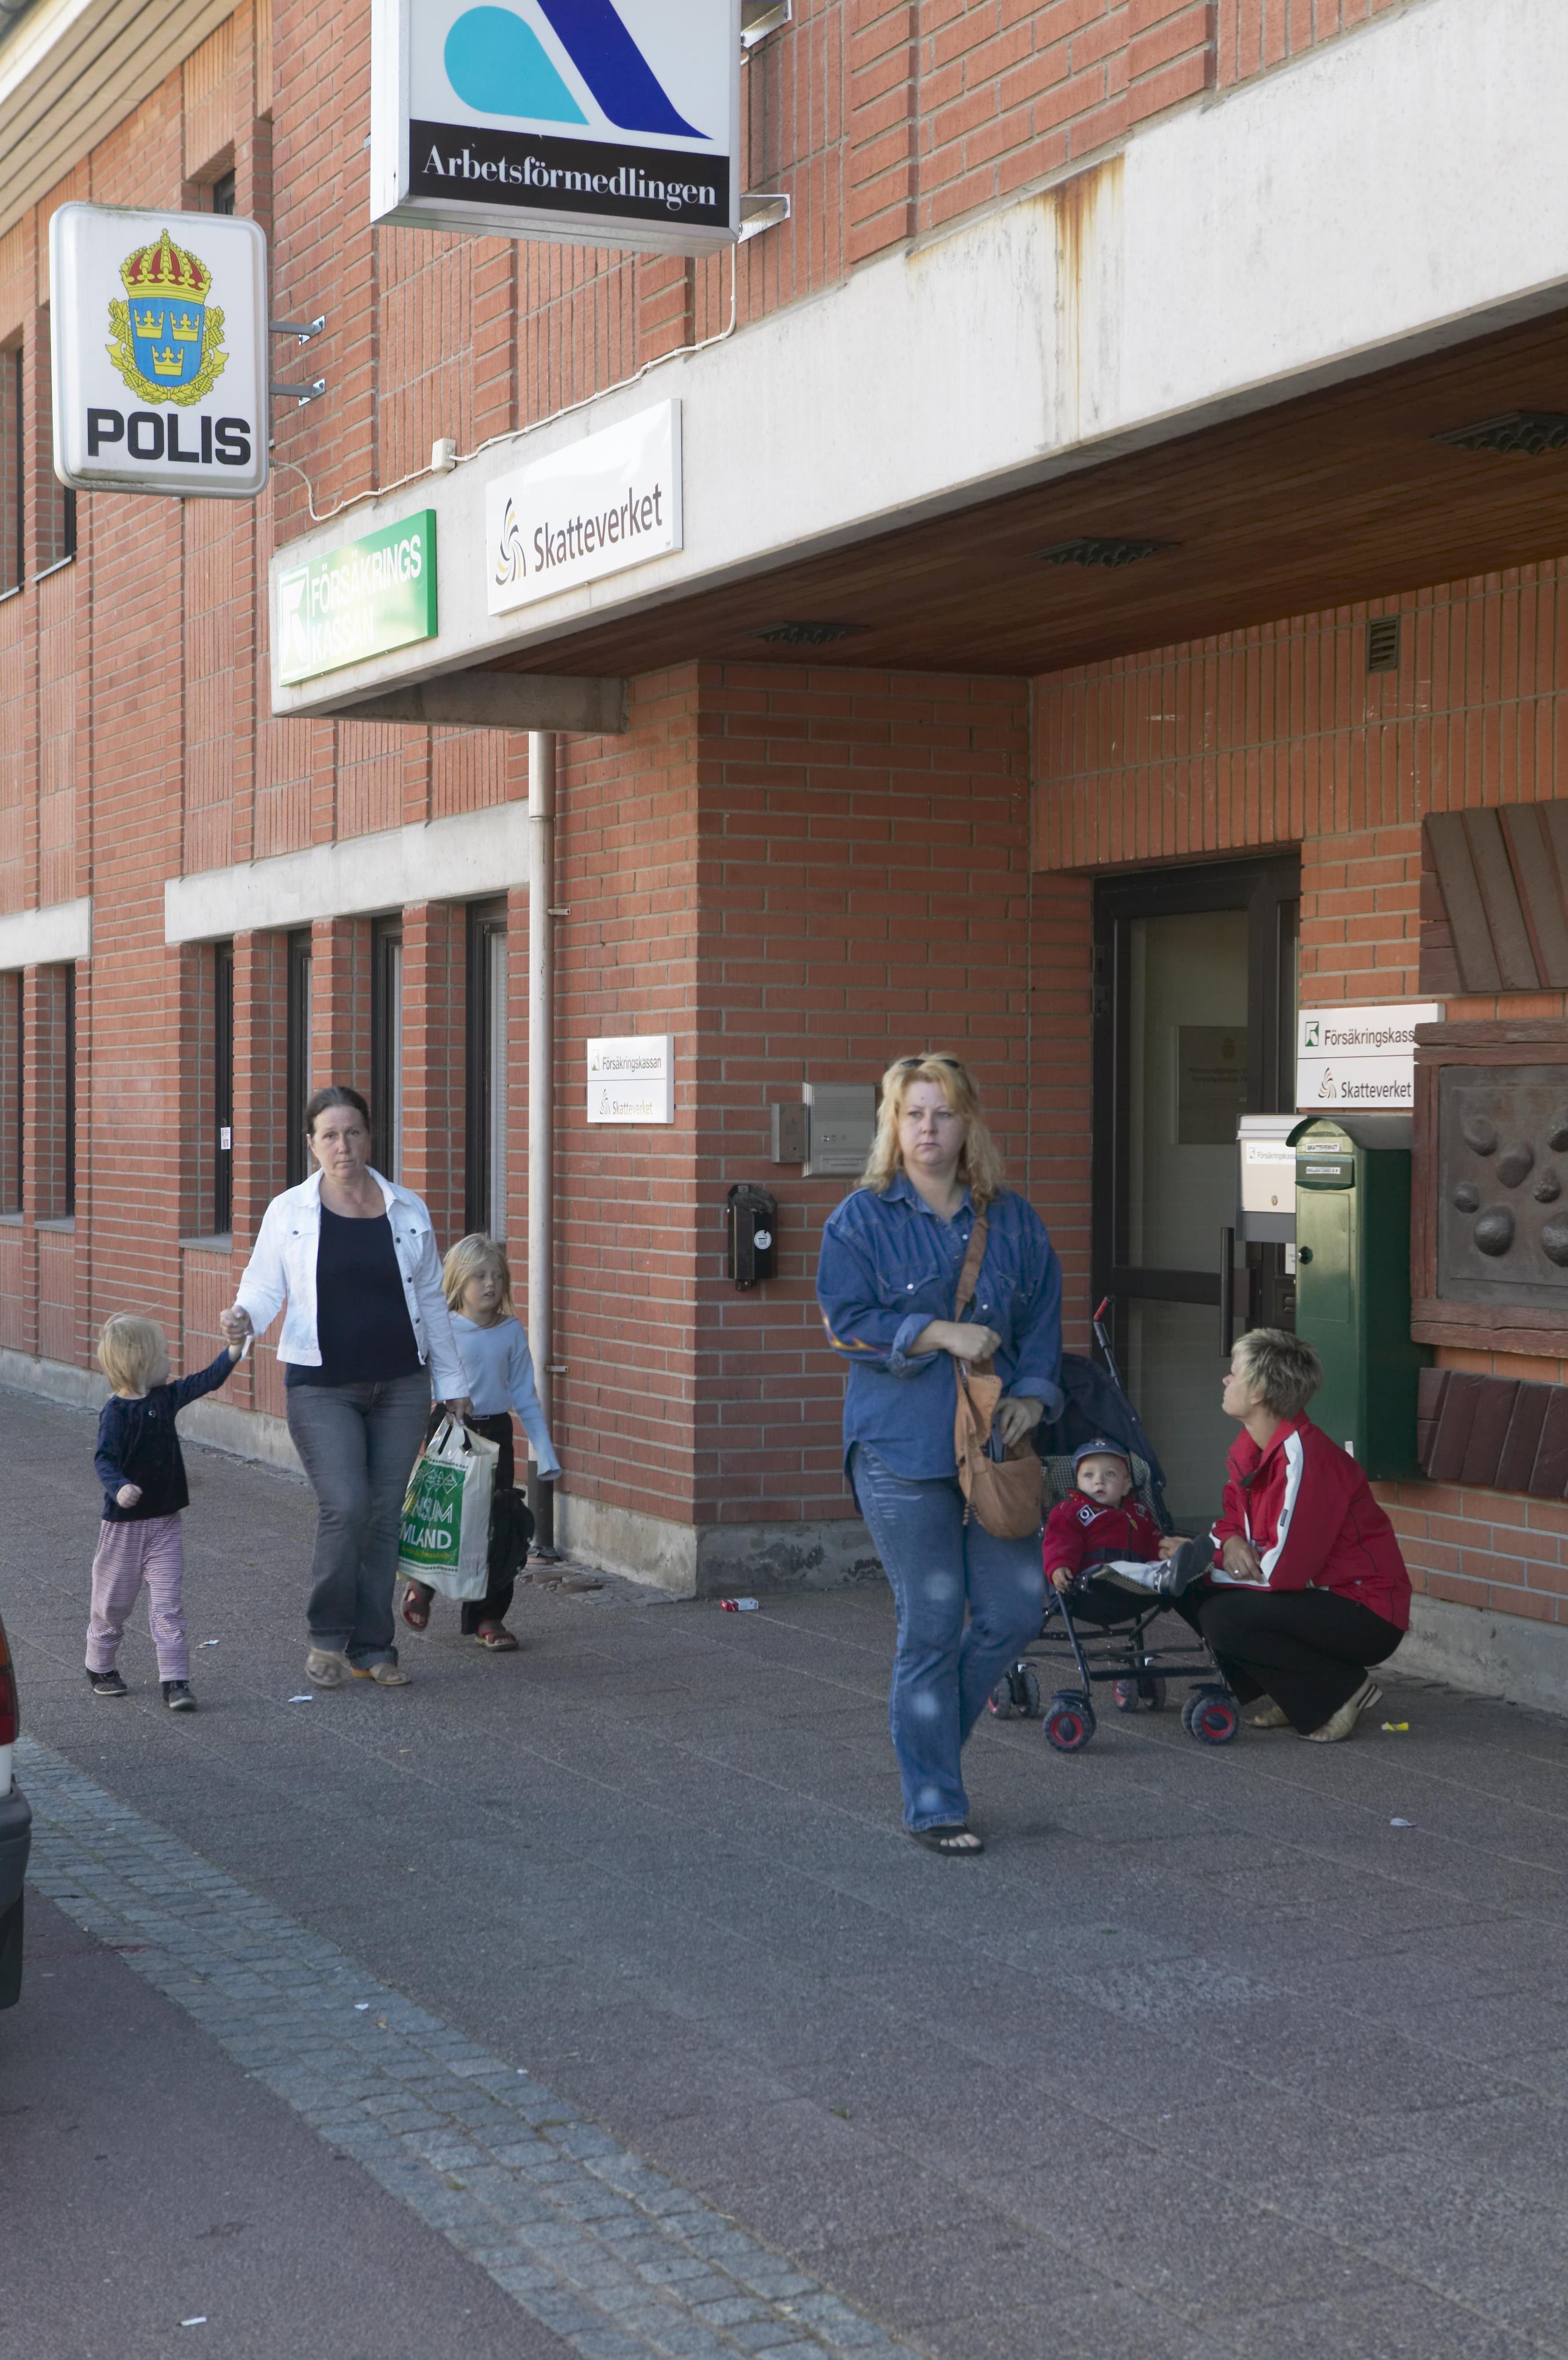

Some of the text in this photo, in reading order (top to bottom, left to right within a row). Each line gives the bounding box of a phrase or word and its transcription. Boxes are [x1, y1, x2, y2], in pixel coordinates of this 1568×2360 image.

[422, 144, 717, 211] Arbetsförmedlingen
[87, 408, 251, 466] POLIS
[534, 483, 662, 573] Skatteverket
[312, 535, 422, 617] FÖRSÄKRINGS
[312, 605, 375, 664] KASSAN
[602, 1056, 661, 1072] Försäkringskassan
[1341, 1080, 1411, 1099] Skatteverket
[613, 1100, 653, 1115] Skatteverket
